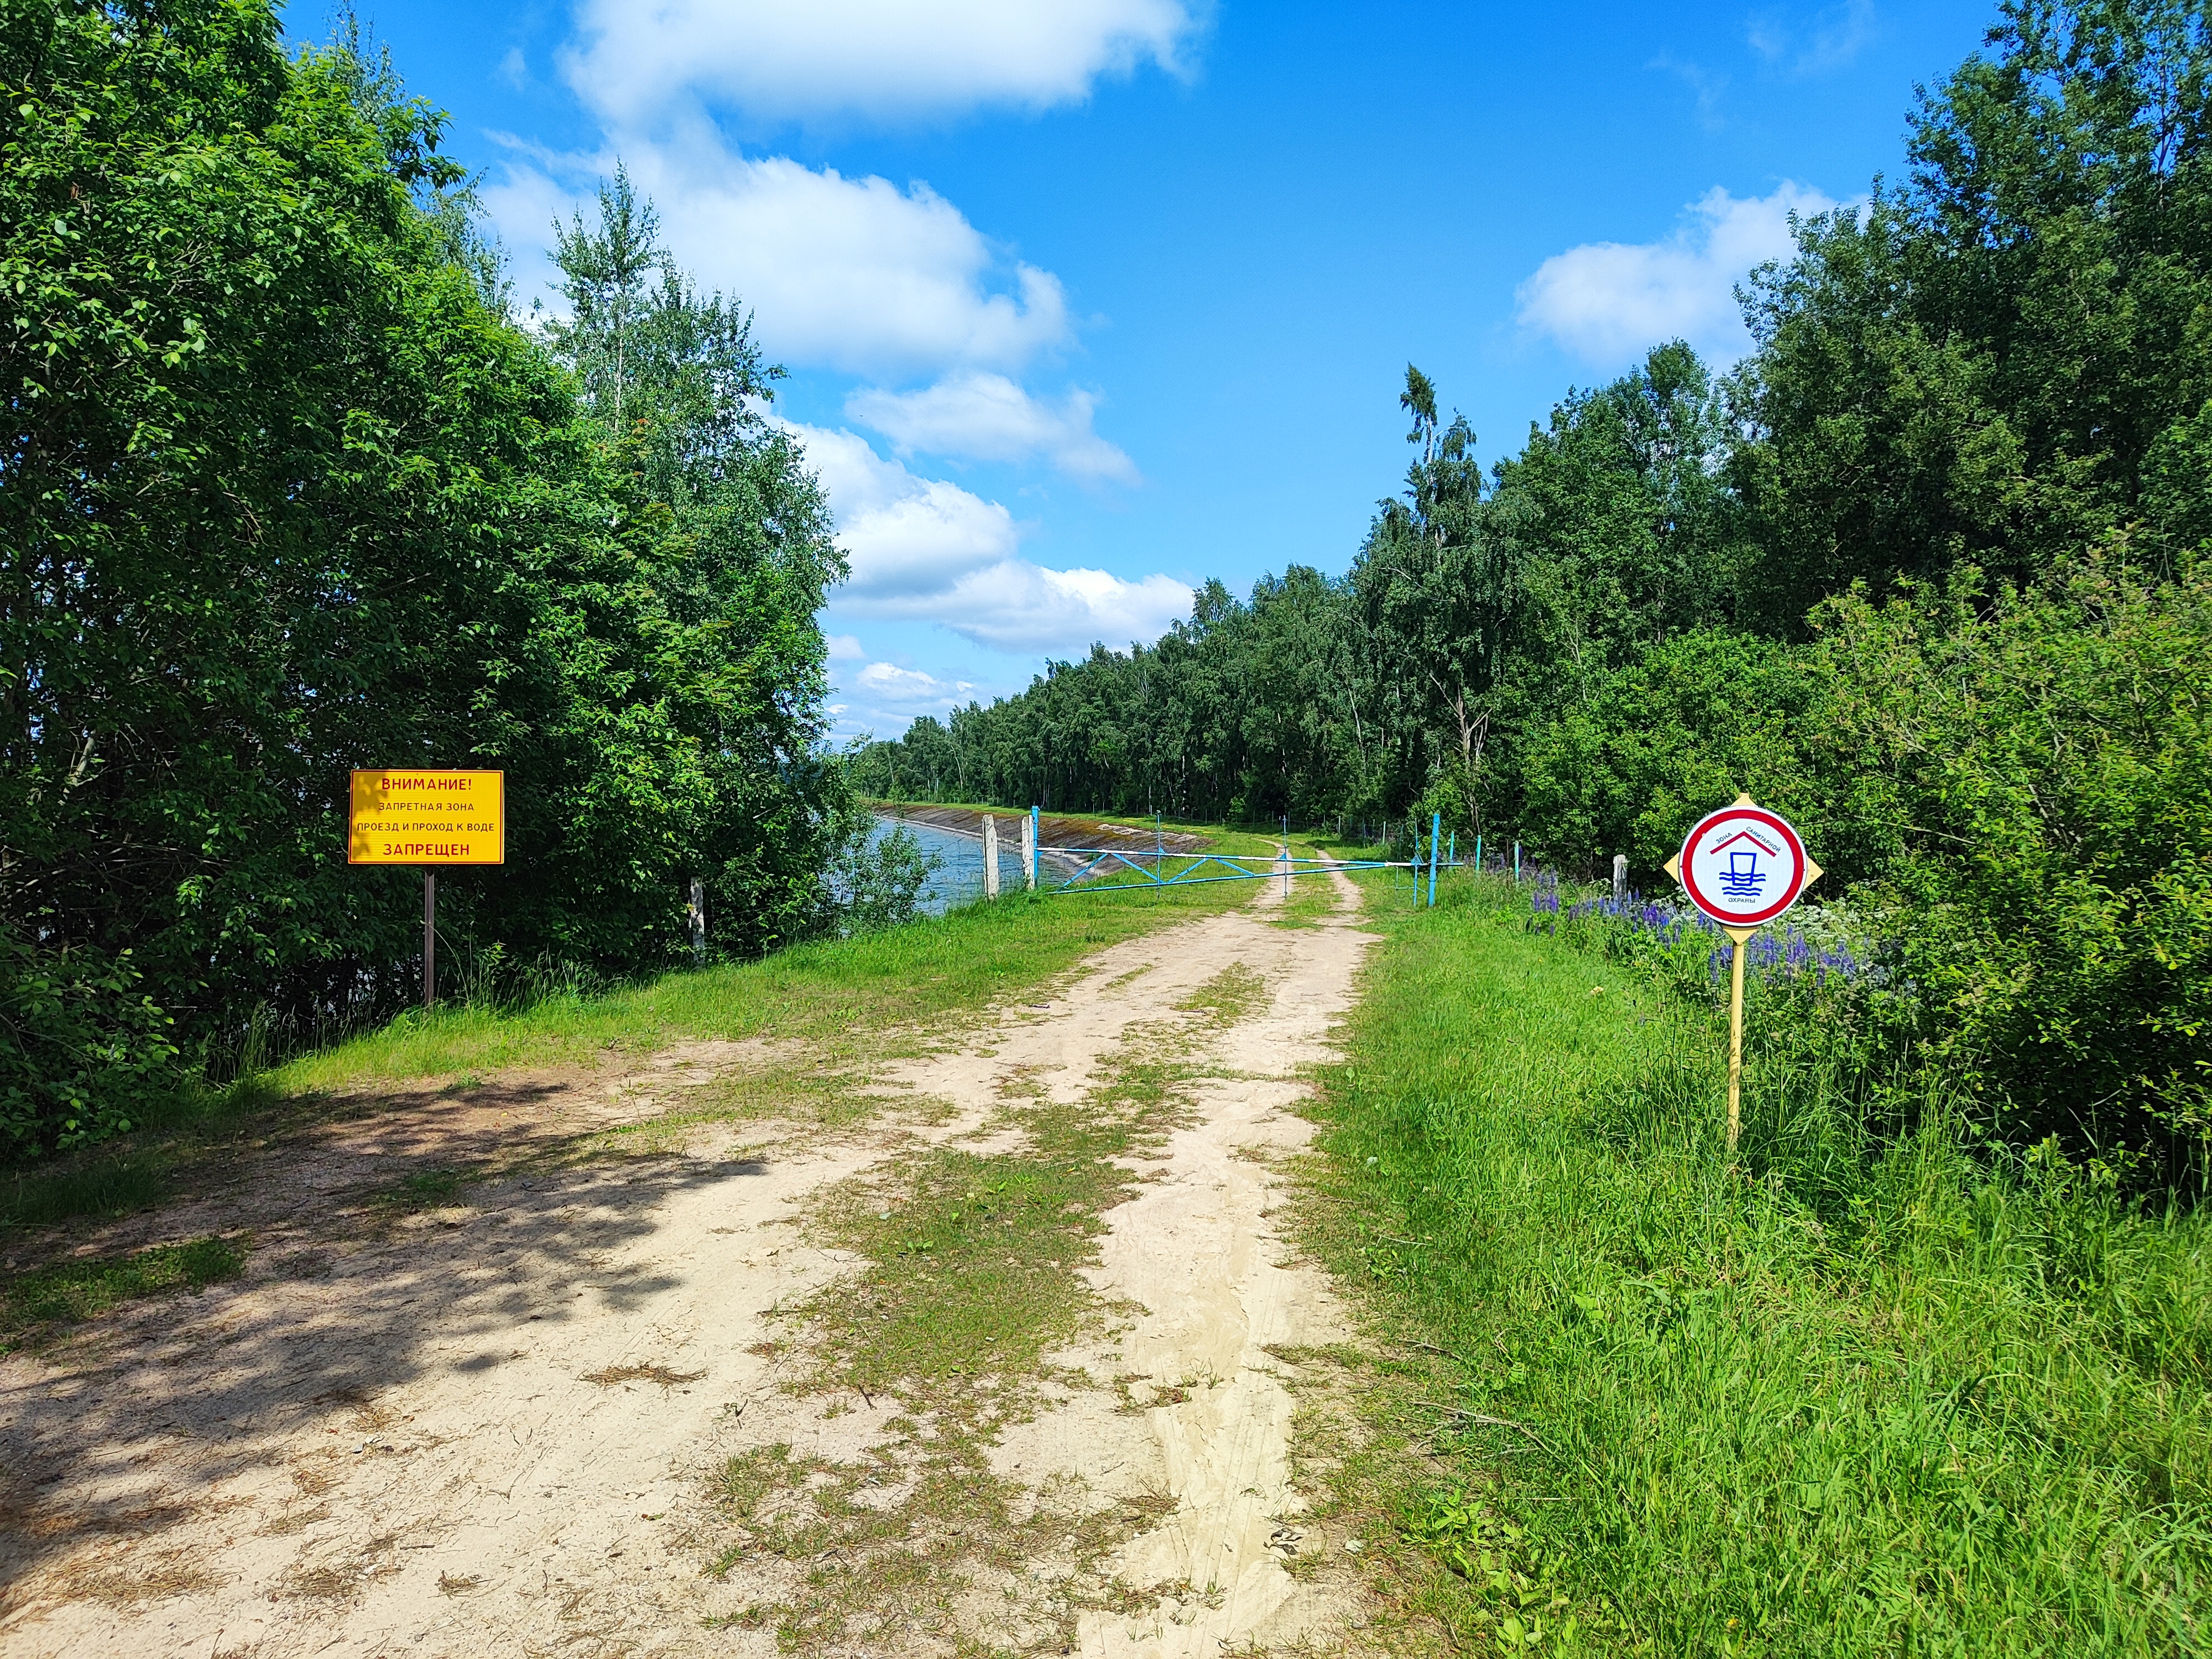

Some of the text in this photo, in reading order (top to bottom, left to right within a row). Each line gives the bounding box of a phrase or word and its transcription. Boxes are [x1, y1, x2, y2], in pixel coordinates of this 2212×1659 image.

[382, 778, 472, 790] ВНИМАНИЕ!
[378, 802, 442, 811] ЗАПРЕТНАЯ
[357, 823, 399, 832] ПРОЕЗД
[413, 823, 453, 832] ПРОХОД
[467, 823, 494, 832] ВОДЕ
[1715, 826, 1781, 853] ЗОНА САНИТАРНОЙ
[383, 844, 469, 857] ЗАПРЕЩЕН
